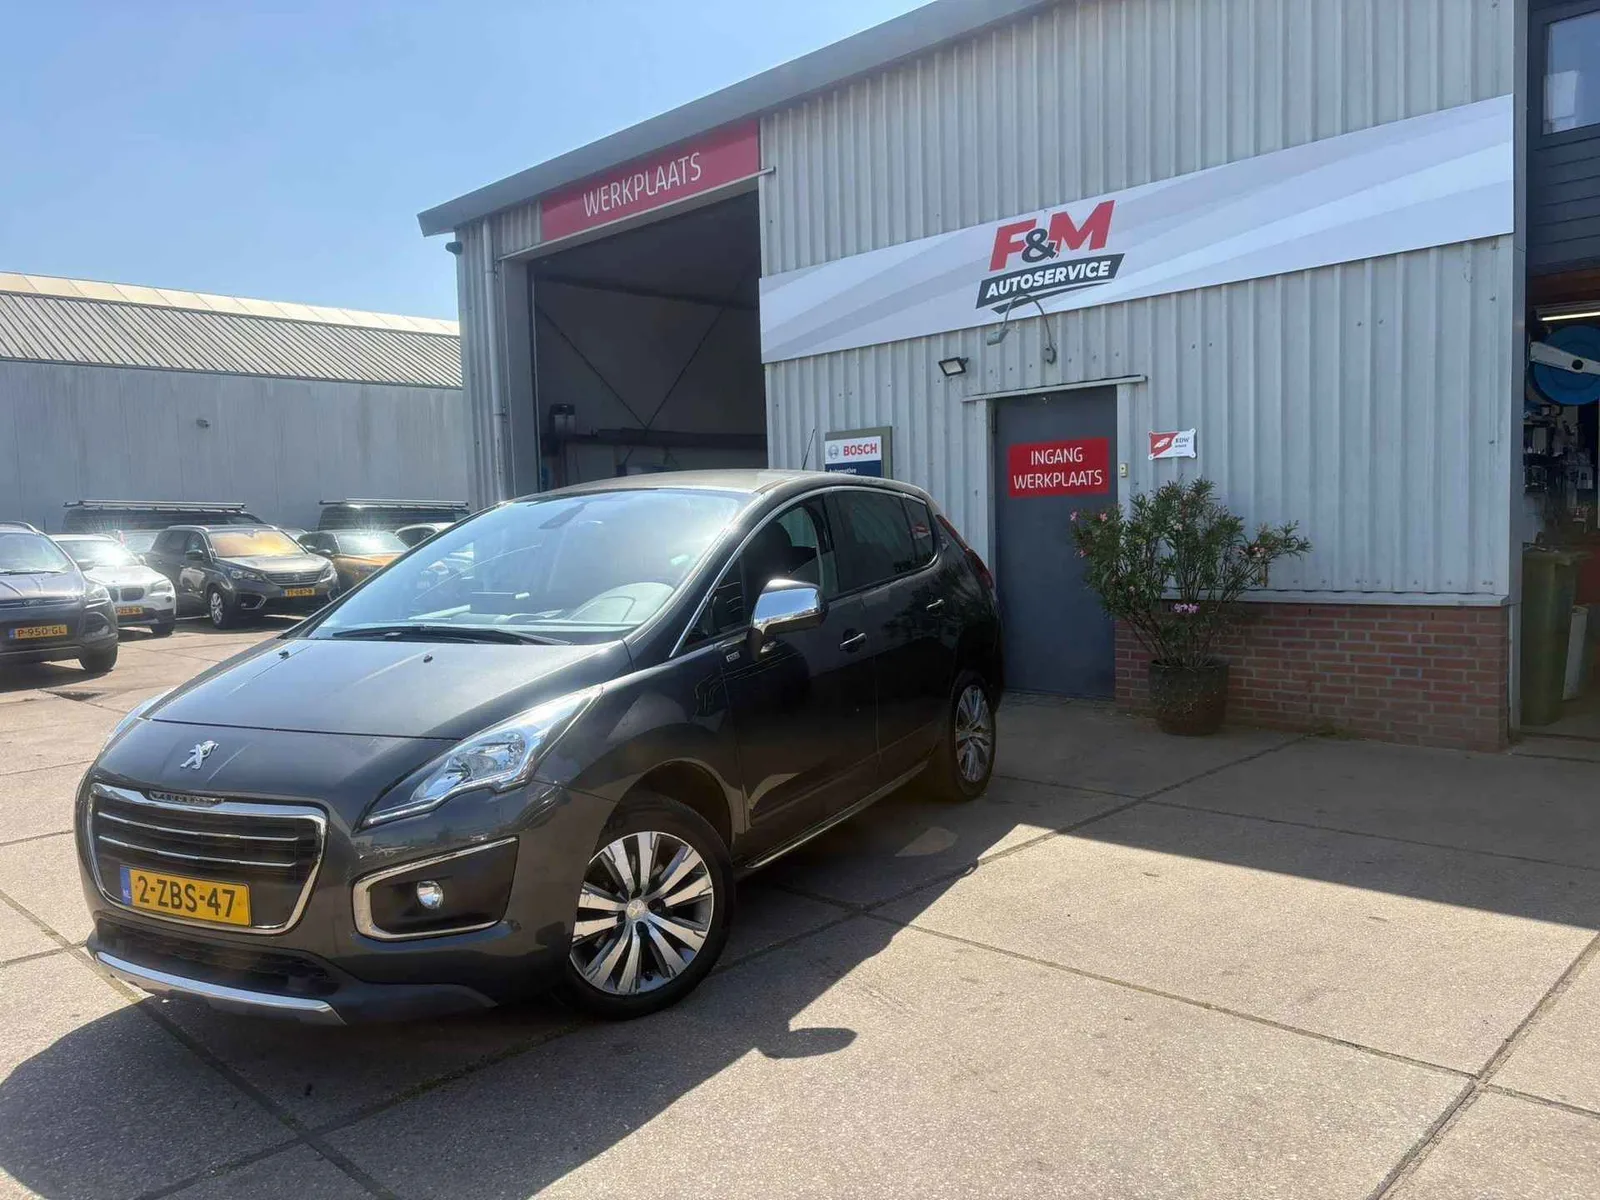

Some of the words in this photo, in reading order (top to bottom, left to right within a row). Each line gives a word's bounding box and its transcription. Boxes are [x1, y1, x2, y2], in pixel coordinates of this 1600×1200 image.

[583, 152, 702, 217] WERKPLAATS
[989, 200, 1115, 272] F&M
[986, 261, 1111, 298] AUTOSERVICE
[843, 443, 877, 456] BOSCH
[1031, 447, 1083, 466] INGANG
[1013, 469, 1103, 489] WERKPLAATS
[138, 876, 235, 917] 2-ZBS-47
